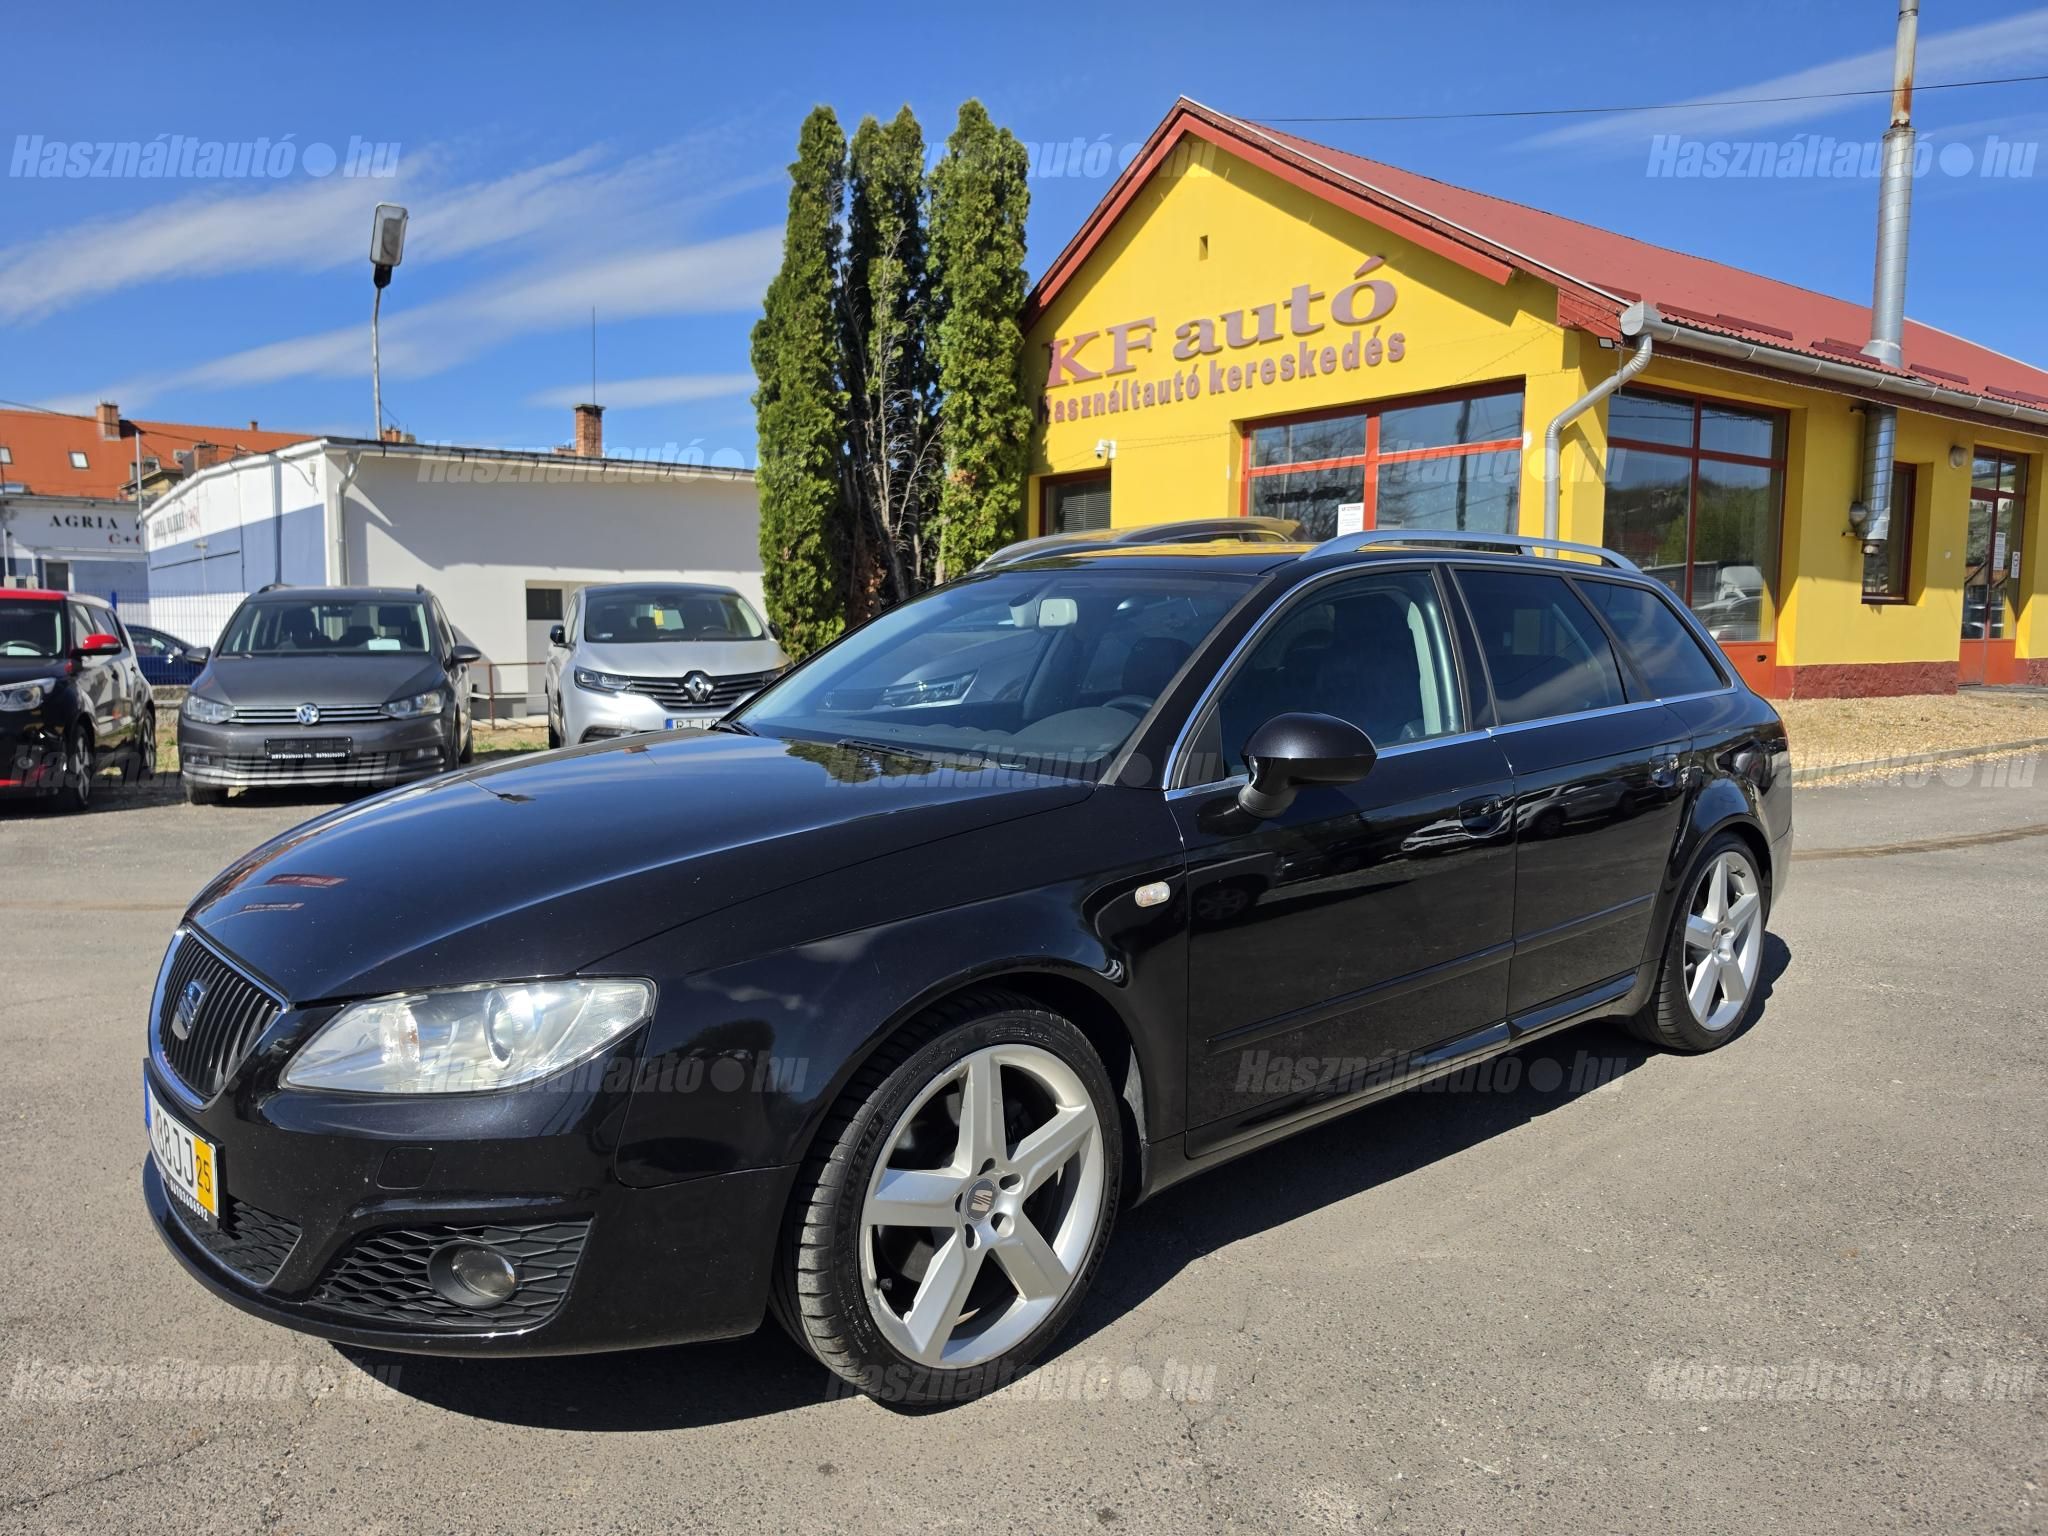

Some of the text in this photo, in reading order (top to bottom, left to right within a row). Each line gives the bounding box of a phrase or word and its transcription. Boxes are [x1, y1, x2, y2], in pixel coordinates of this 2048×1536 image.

[1041, 255, 1397, 388] KF autó
[1209, 326, 1406, 395] kereskedés
[50, 515, 118, 529] AGRIA
